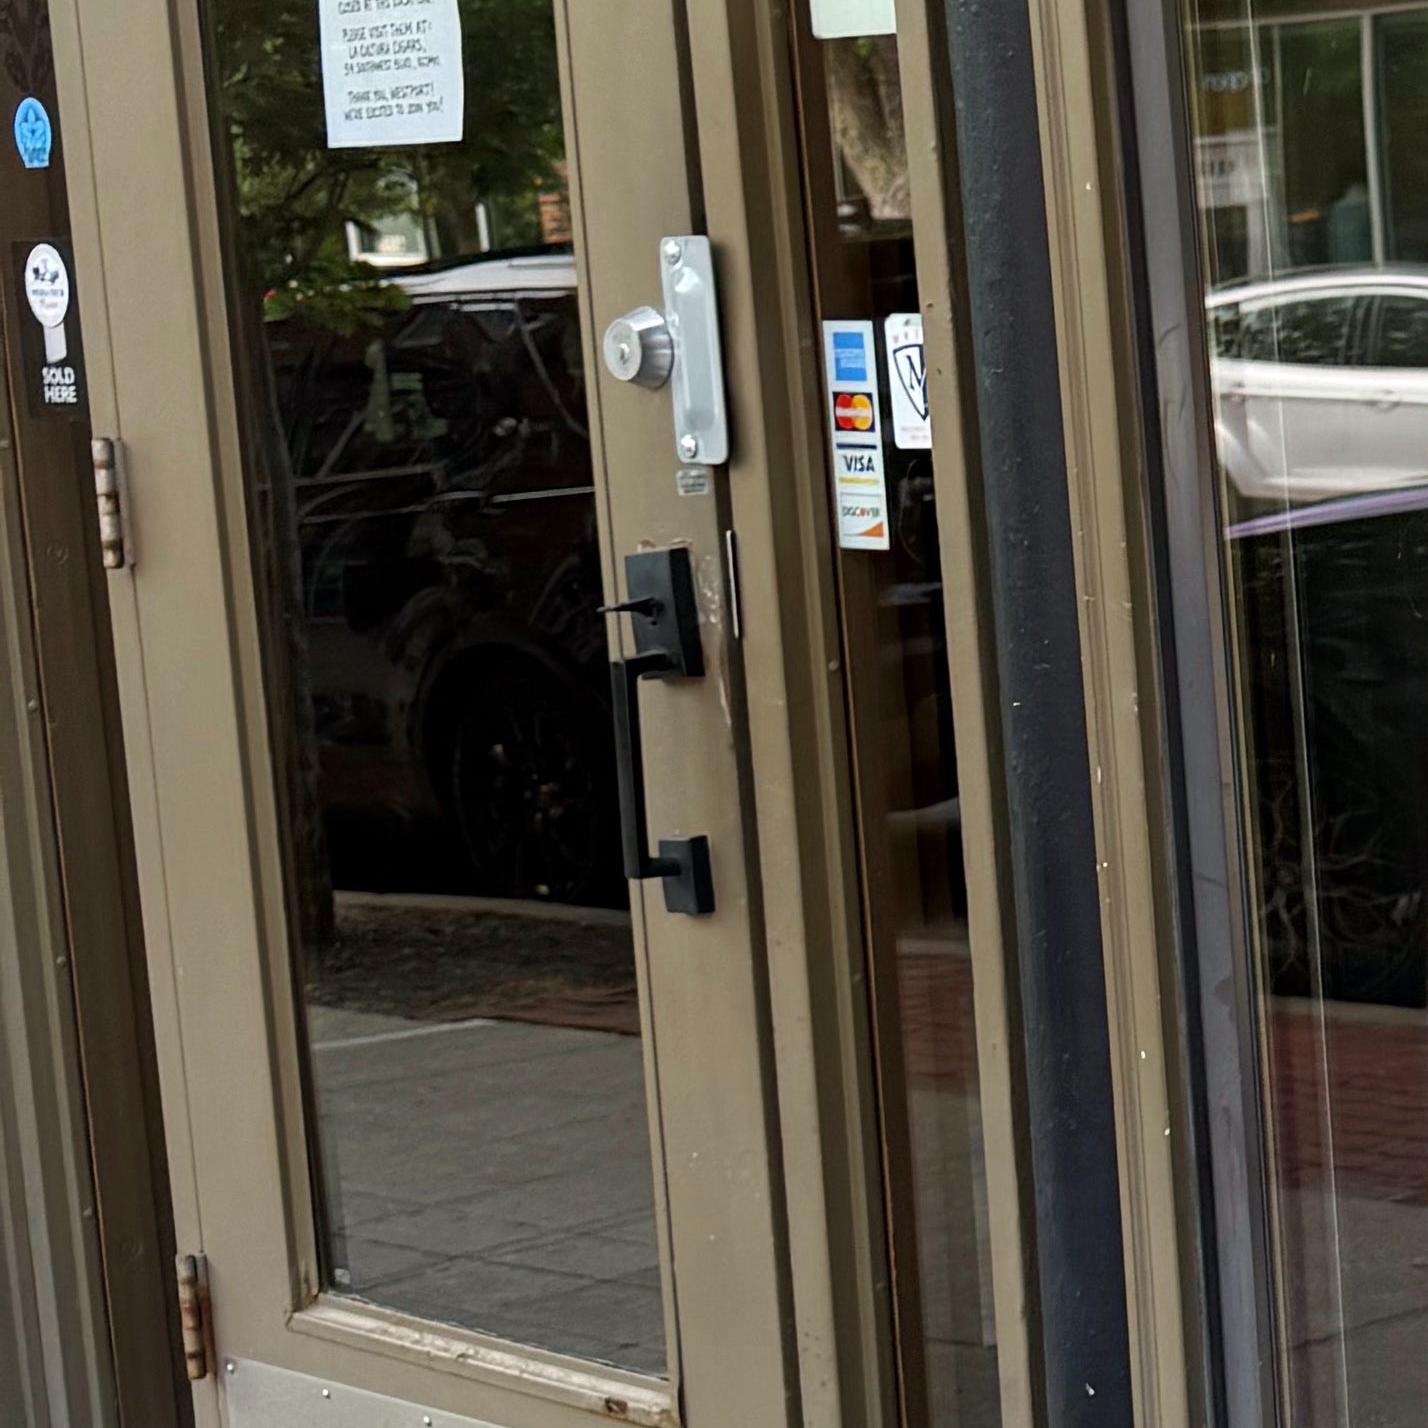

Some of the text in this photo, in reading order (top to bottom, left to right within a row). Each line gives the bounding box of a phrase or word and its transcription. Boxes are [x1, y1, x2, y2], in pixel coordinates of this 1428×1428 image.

[42, 366, 75, 386] SOLD
[44, 385, 77, 404] HERE
[844, 455, 875, 473] VISA
